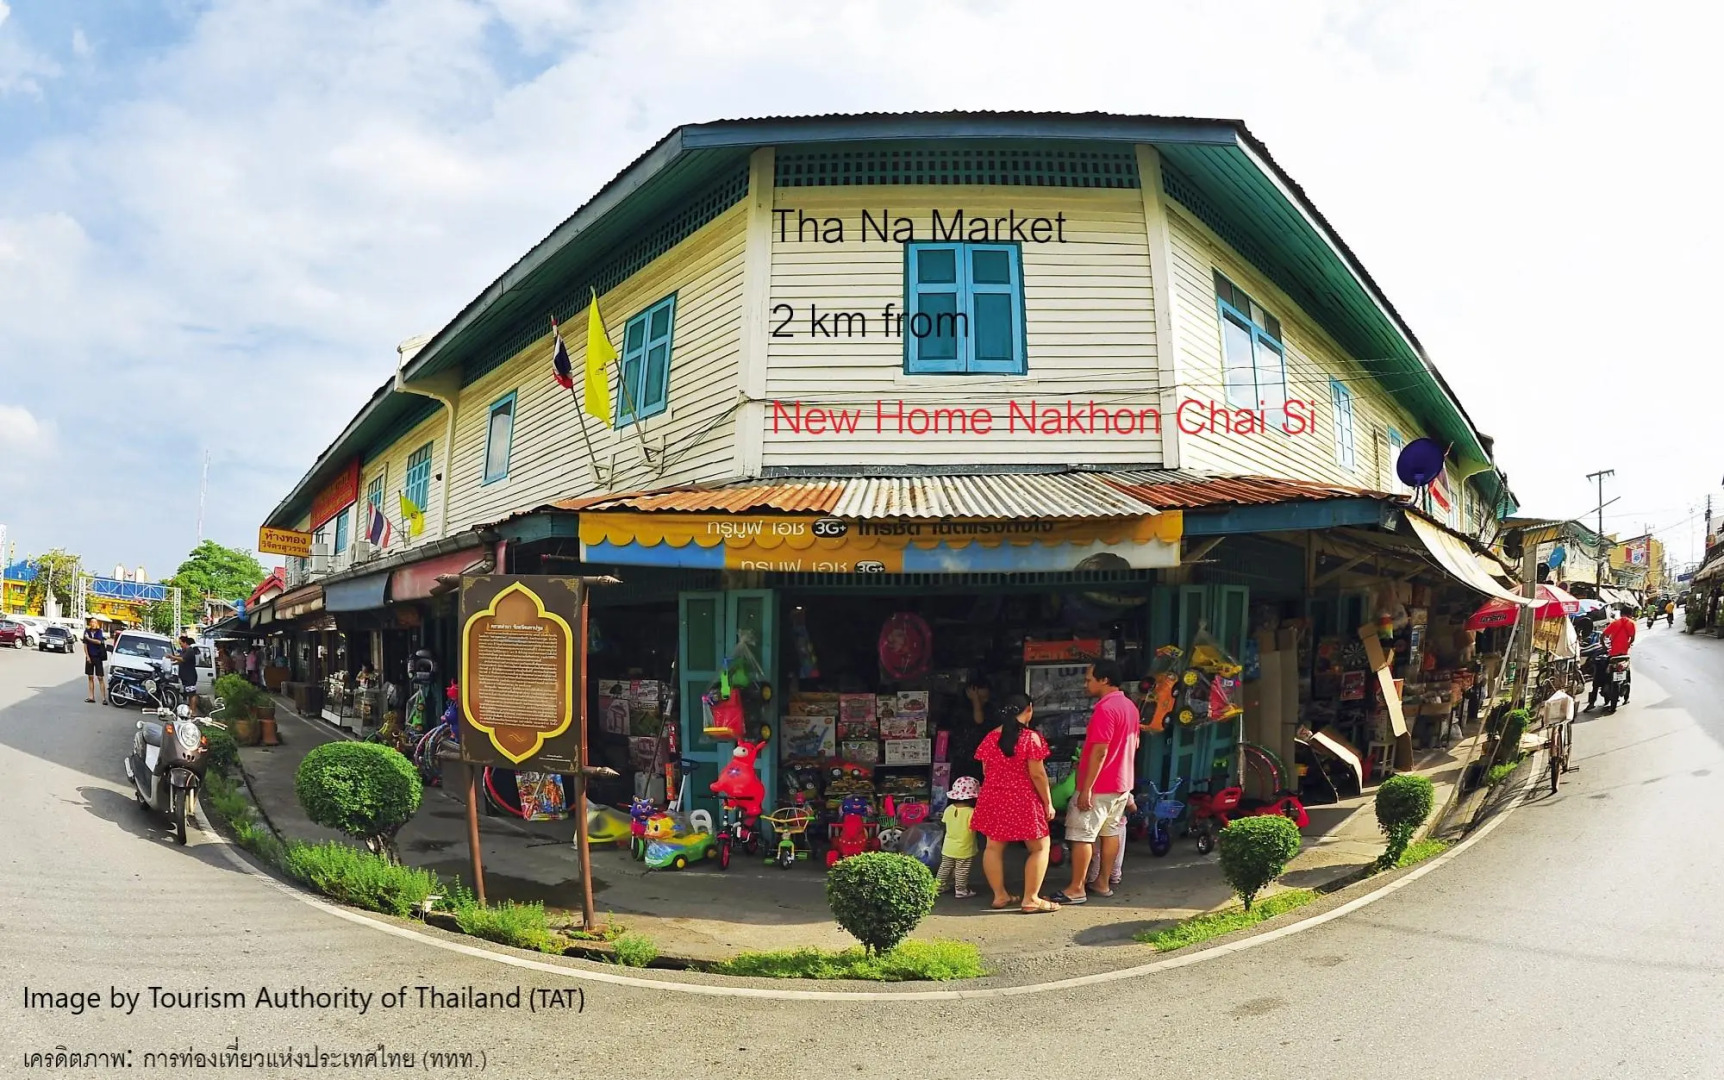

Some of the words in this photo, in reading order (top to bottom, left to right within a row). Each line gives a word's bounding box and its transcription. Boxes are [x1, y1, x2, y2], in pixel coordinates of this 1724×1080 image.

[264, 530, 307, 545] ห้างทอง
[707, 519, 763, 539] ทรูมูฟ
[772, 521, 805, 536] เอช
